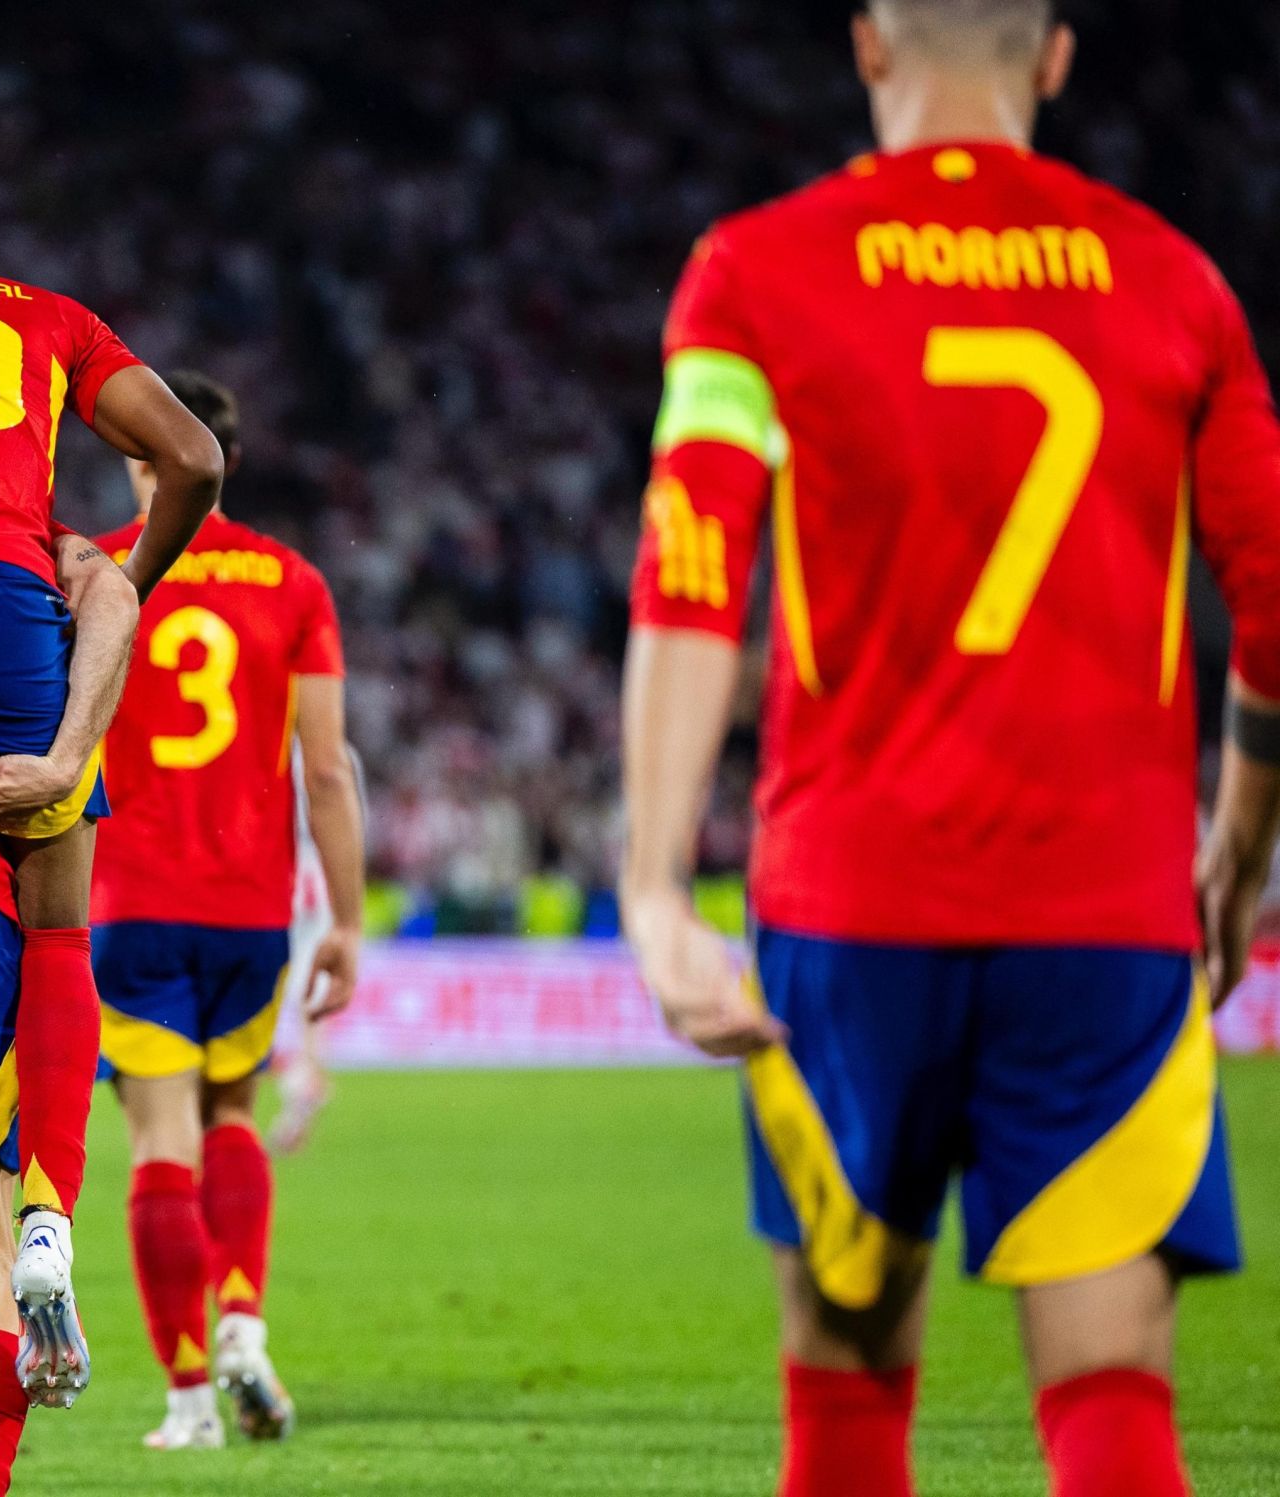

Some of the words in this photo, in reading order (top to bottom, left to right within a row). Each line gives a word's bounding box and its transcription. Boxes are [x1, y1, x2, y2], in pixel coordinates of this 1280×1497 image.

[856, 220, 1113, 294] MORATA
[922, 326, 1104, 656] 7
[148, 604, 239, 770] 3
